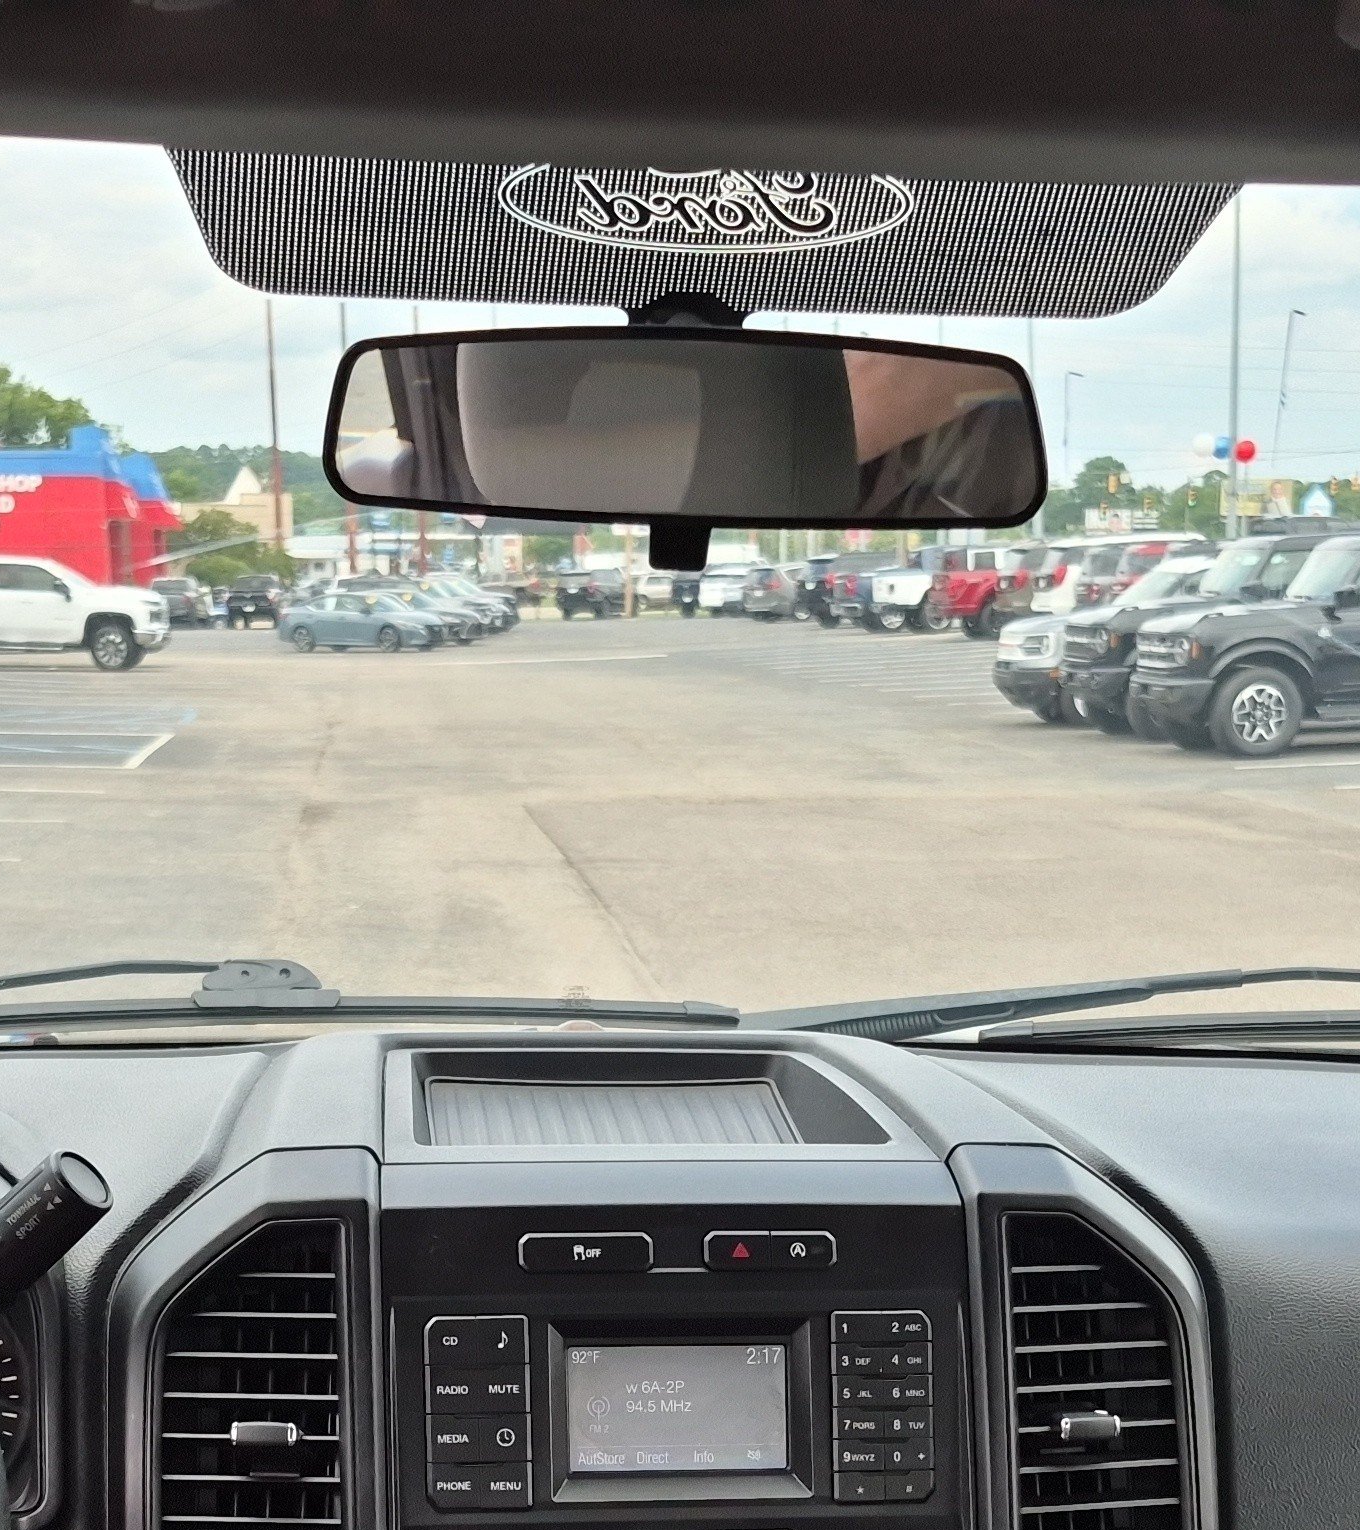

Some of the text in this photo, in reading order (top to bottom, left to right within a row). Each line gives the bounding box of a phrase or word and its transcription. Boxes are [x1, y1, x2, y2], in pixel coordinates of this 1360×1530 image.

[15, 1213, 40, 1240] SPORT
[585, 1248, 602, 1258] OFF
[891, 1322, 922, 1333] 2 ABC
[442, 1336, 459, 1346] CD
[571, 1350, 601, 1365] 92°F
[745, 1346, 782, 1365] 2:17
[841, 1355, 872, 1367] 3 DEF
[891, 1354, 922, 1365] 4 GHI
[436, 1385, 469, 1395] RADIO
[488, 1384, 521, 1394] MUTE
[641, 1380, 686, 1394] 6A-2P
[842, 1387, 873, 1399] 5 JKL
[892, 1387, 925, 1399] 6 MNO
[625, 1399, 692, 1414] 94.5 MHz
[590, 1424, 602, 1434] FM
[843, 1419, 851, 1431] 7
[892, 1419, 925, 1431] 8 TUV
[437, 1433, 470, 1444] MEDIA
[636, 1450, 670, 1465] Direct
[693, 1450, 715, 1464] Info
[843, 1451, 875, 1463] 9 WXYZ
[893, 1451, 901, 1462] 0
[436, 1480, 472, 1491] PHONE
[490, 1481, 522, 1491] MENU
